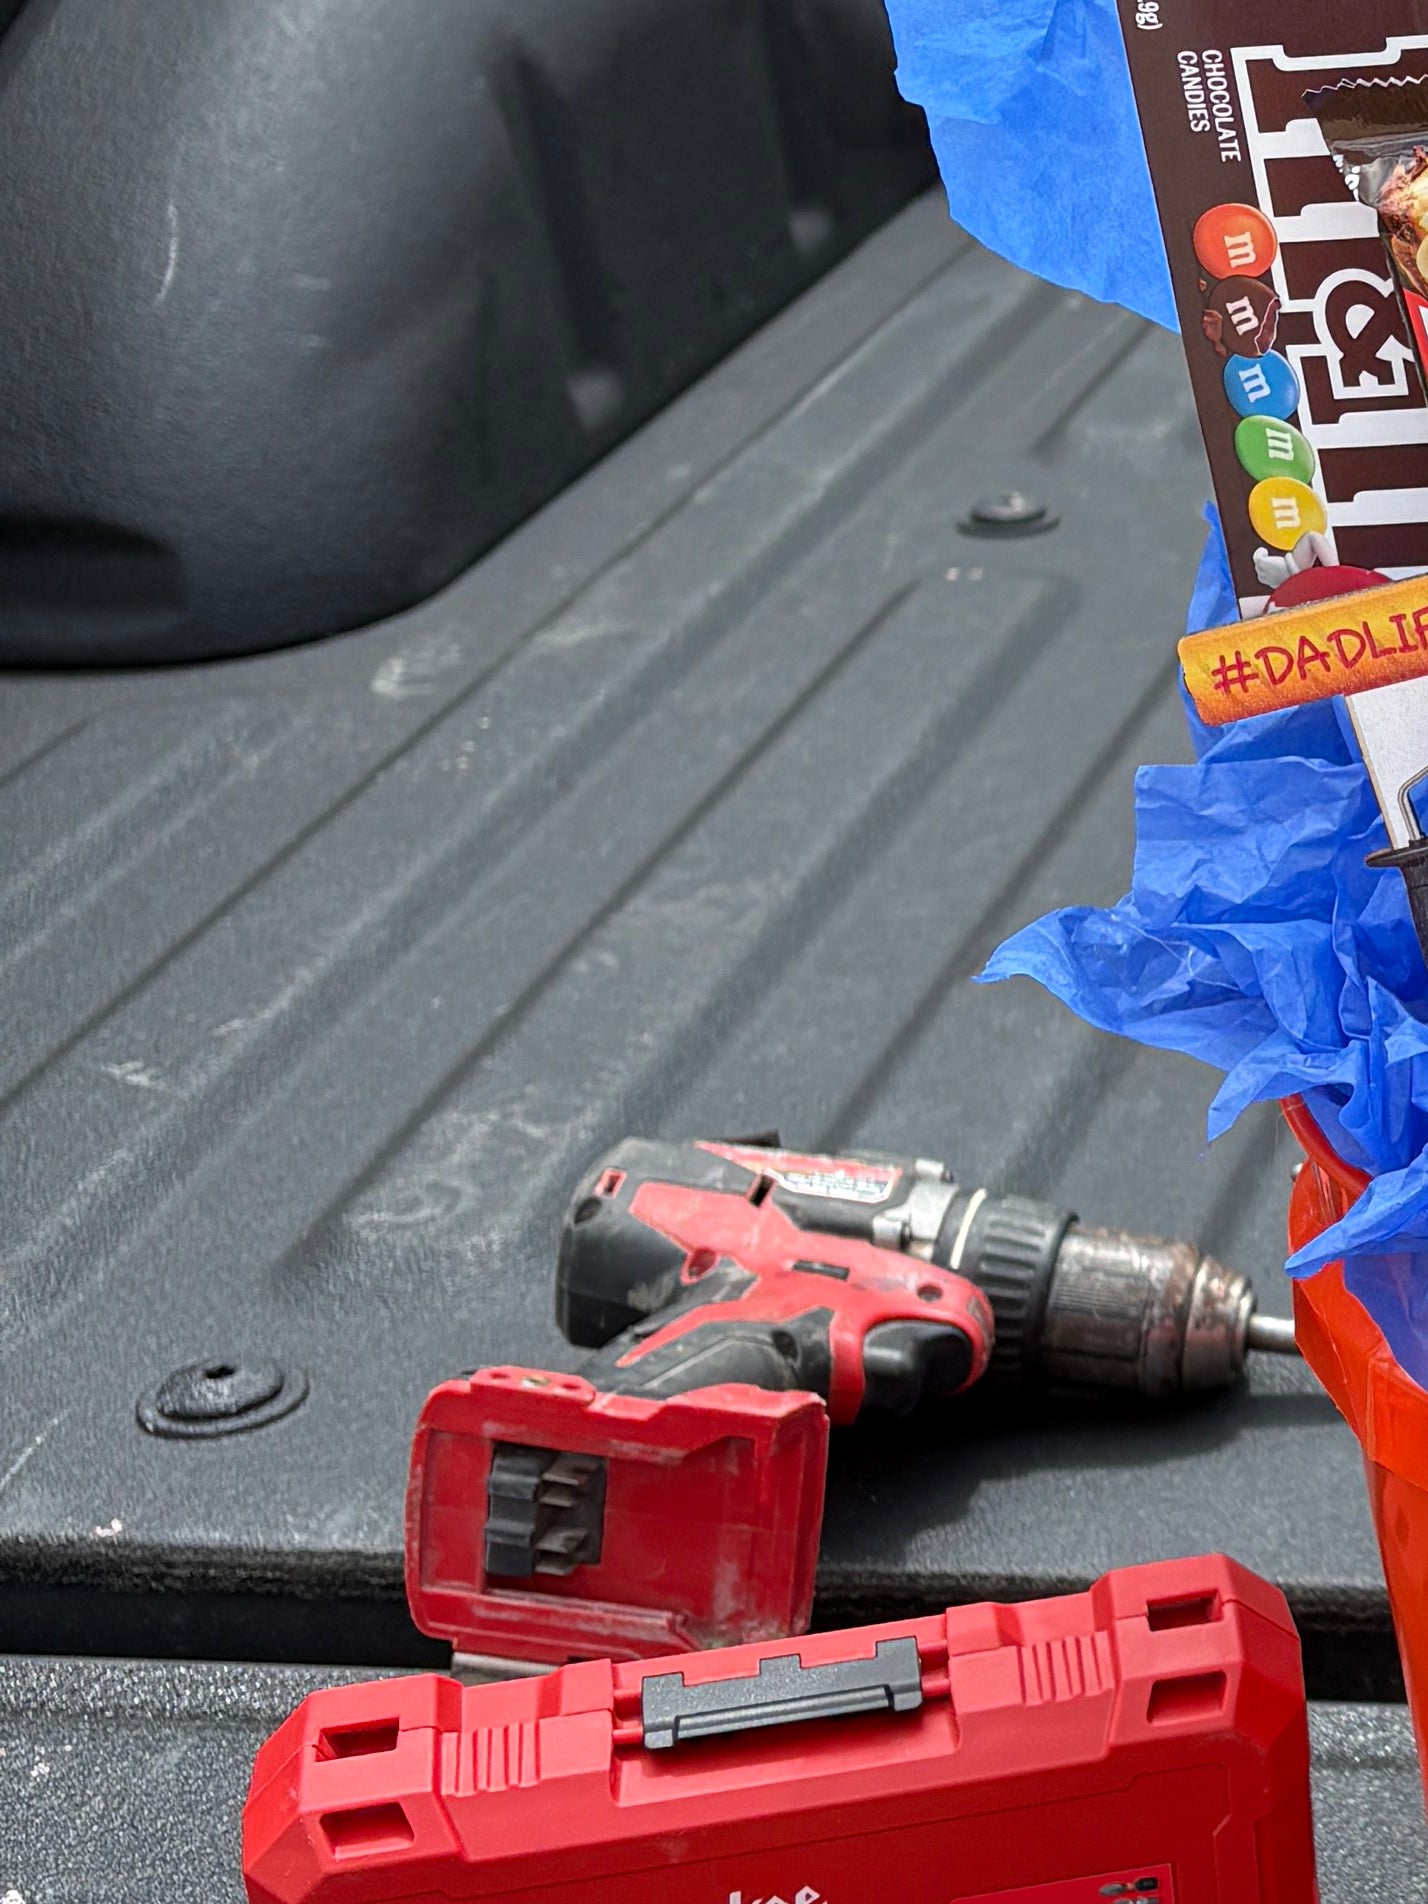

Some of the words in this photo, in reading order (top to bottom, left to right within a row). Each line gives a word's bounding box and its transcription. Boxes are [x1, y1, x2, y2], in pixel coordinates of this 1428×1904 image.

[1177, 51, 1210, 133] CANDIES
[1202, 49, 1241, 163] CHOCOLATE
[1225, 232, 1256, 267] m
[1230, 298, 1260, 335] m
[1239, 367, 1270, 402] m
[1267, 427, 1294, 463] m
[1272, 496, 1299, 531] m
